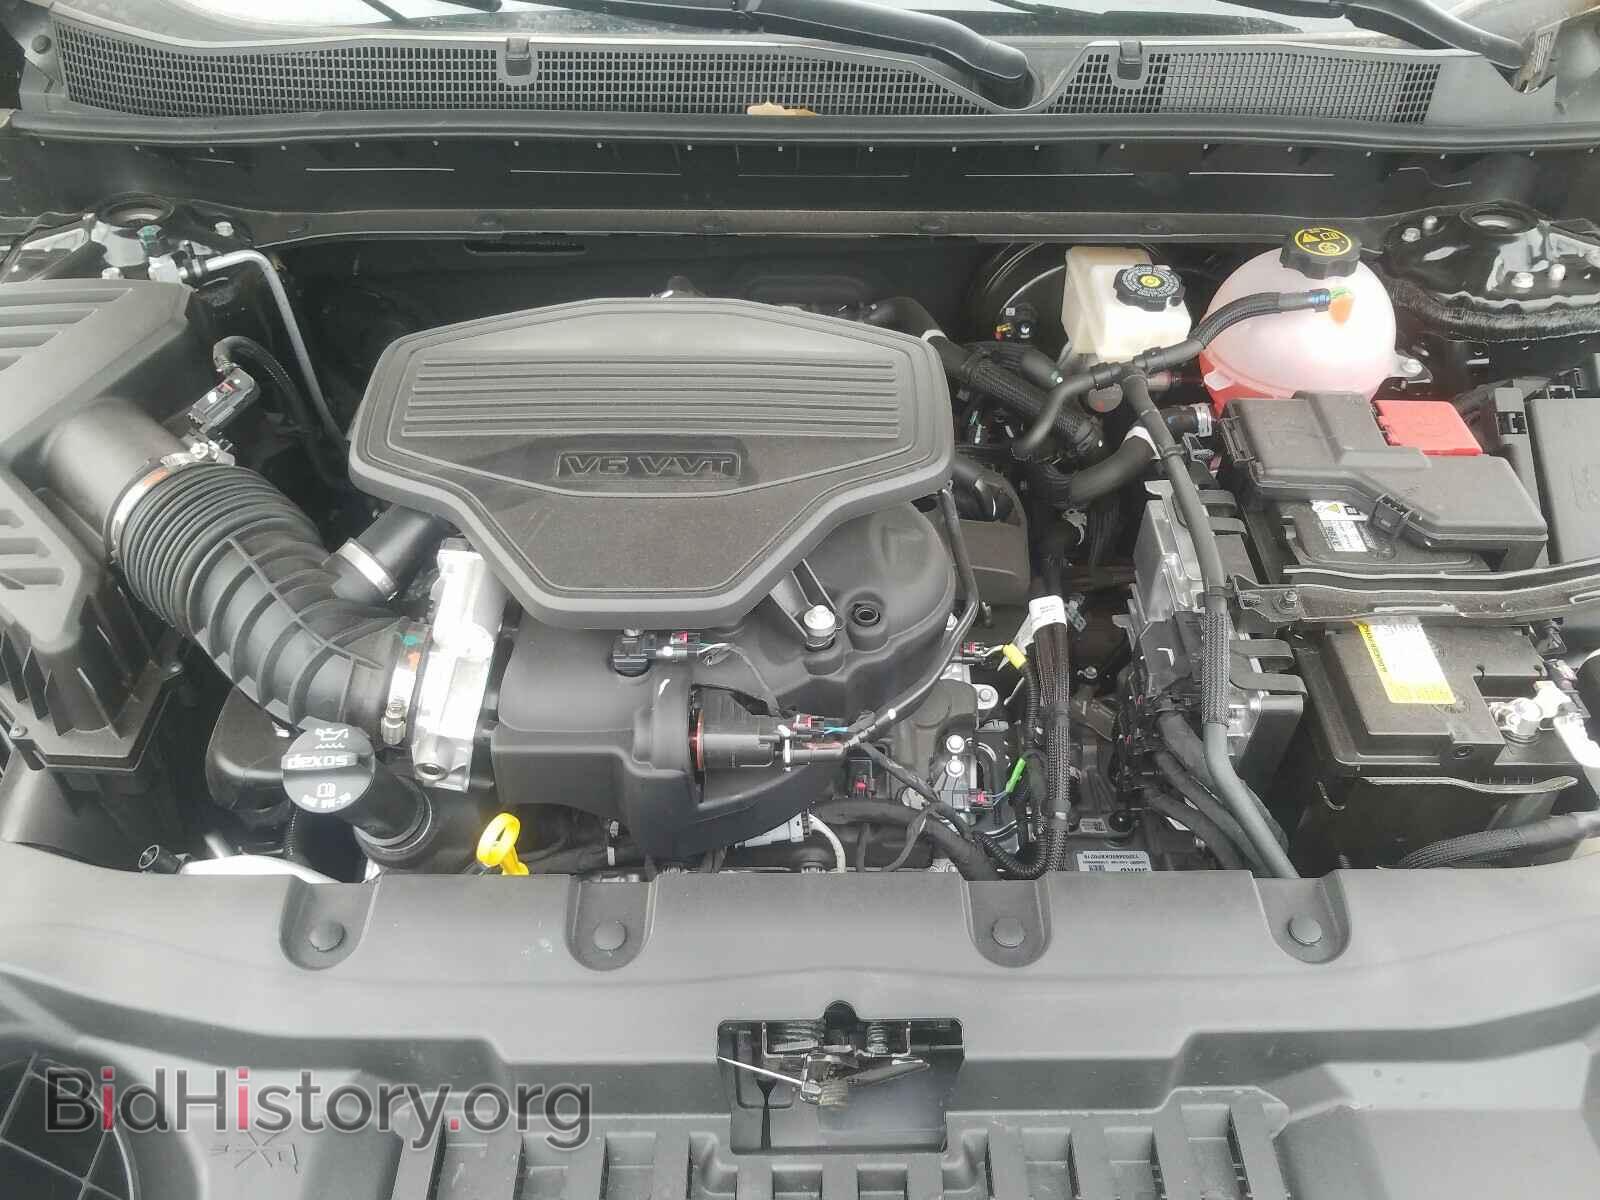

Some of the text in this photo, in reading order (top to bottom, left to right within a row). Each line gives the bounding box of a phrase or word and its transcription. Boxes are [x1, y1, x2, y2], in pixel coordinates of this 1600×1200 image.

[566, 455, 733, 476] V6 VVT
[287, 754, 348, 769] dexos
